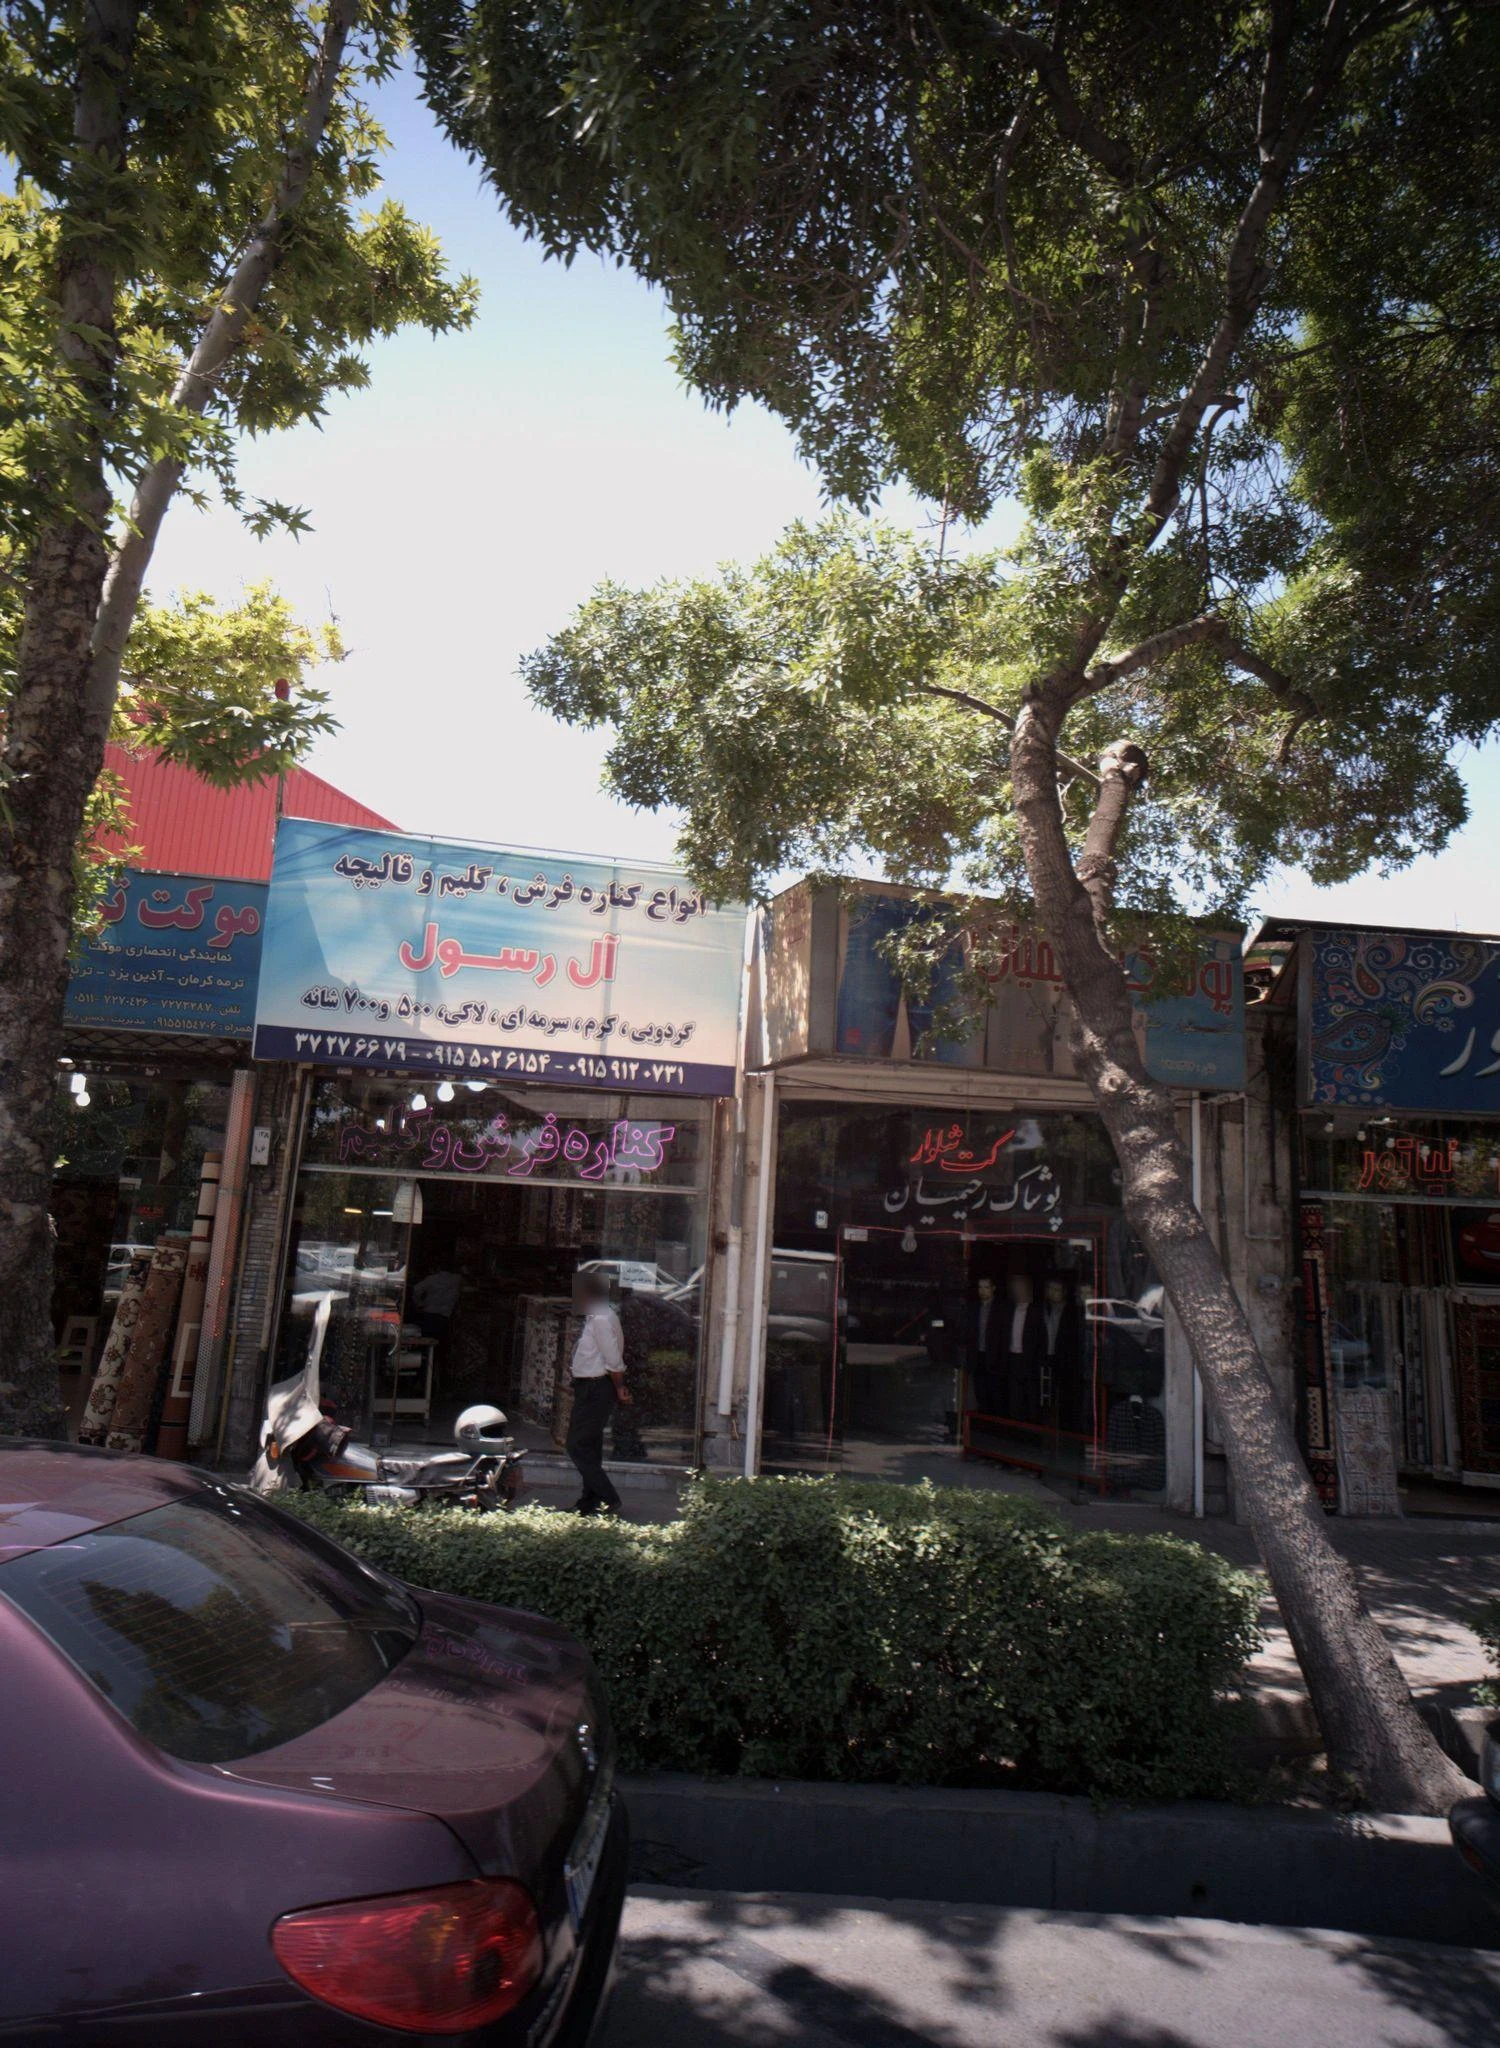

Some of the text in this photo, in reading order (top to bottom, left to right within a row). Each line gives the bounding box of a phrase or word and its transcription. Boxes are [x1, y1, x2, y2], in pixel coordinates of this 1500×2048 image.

[334, 851, 414, 890] قالیچه
[416, 869, 434, 896] و
[438, 863, 494, 898] گلیم
[580, 880, 644, 916] کناره
[646, 885, 708, 924] انواع
[138, 885, 260, 948] موکت
[88, 941, 232, 963] نمایندگی انحصاری موکت
[399, 921, 622, 990] آل رسول
[108, 967, 130, 981] یزد
[132, 969, 165, 983] آذین
[178, 974, 213, 987] کرمان
[216, 977, 244, 990] ترمه
[301, 985, 341, 1009] شانه
[396, 993, 433, 1019] ۵۰۰
[527, 1009, 571, 1035] سرمه
[422, 1126, 451, 1169] و
[452, 1113, 560, 1177] فرش
[564, 1120, 675, 1181] کناره
[909, 1122, 1017, 1172] کت شلوار
[883, 1165, 1063, 1233] پوشاک رحیمیان
